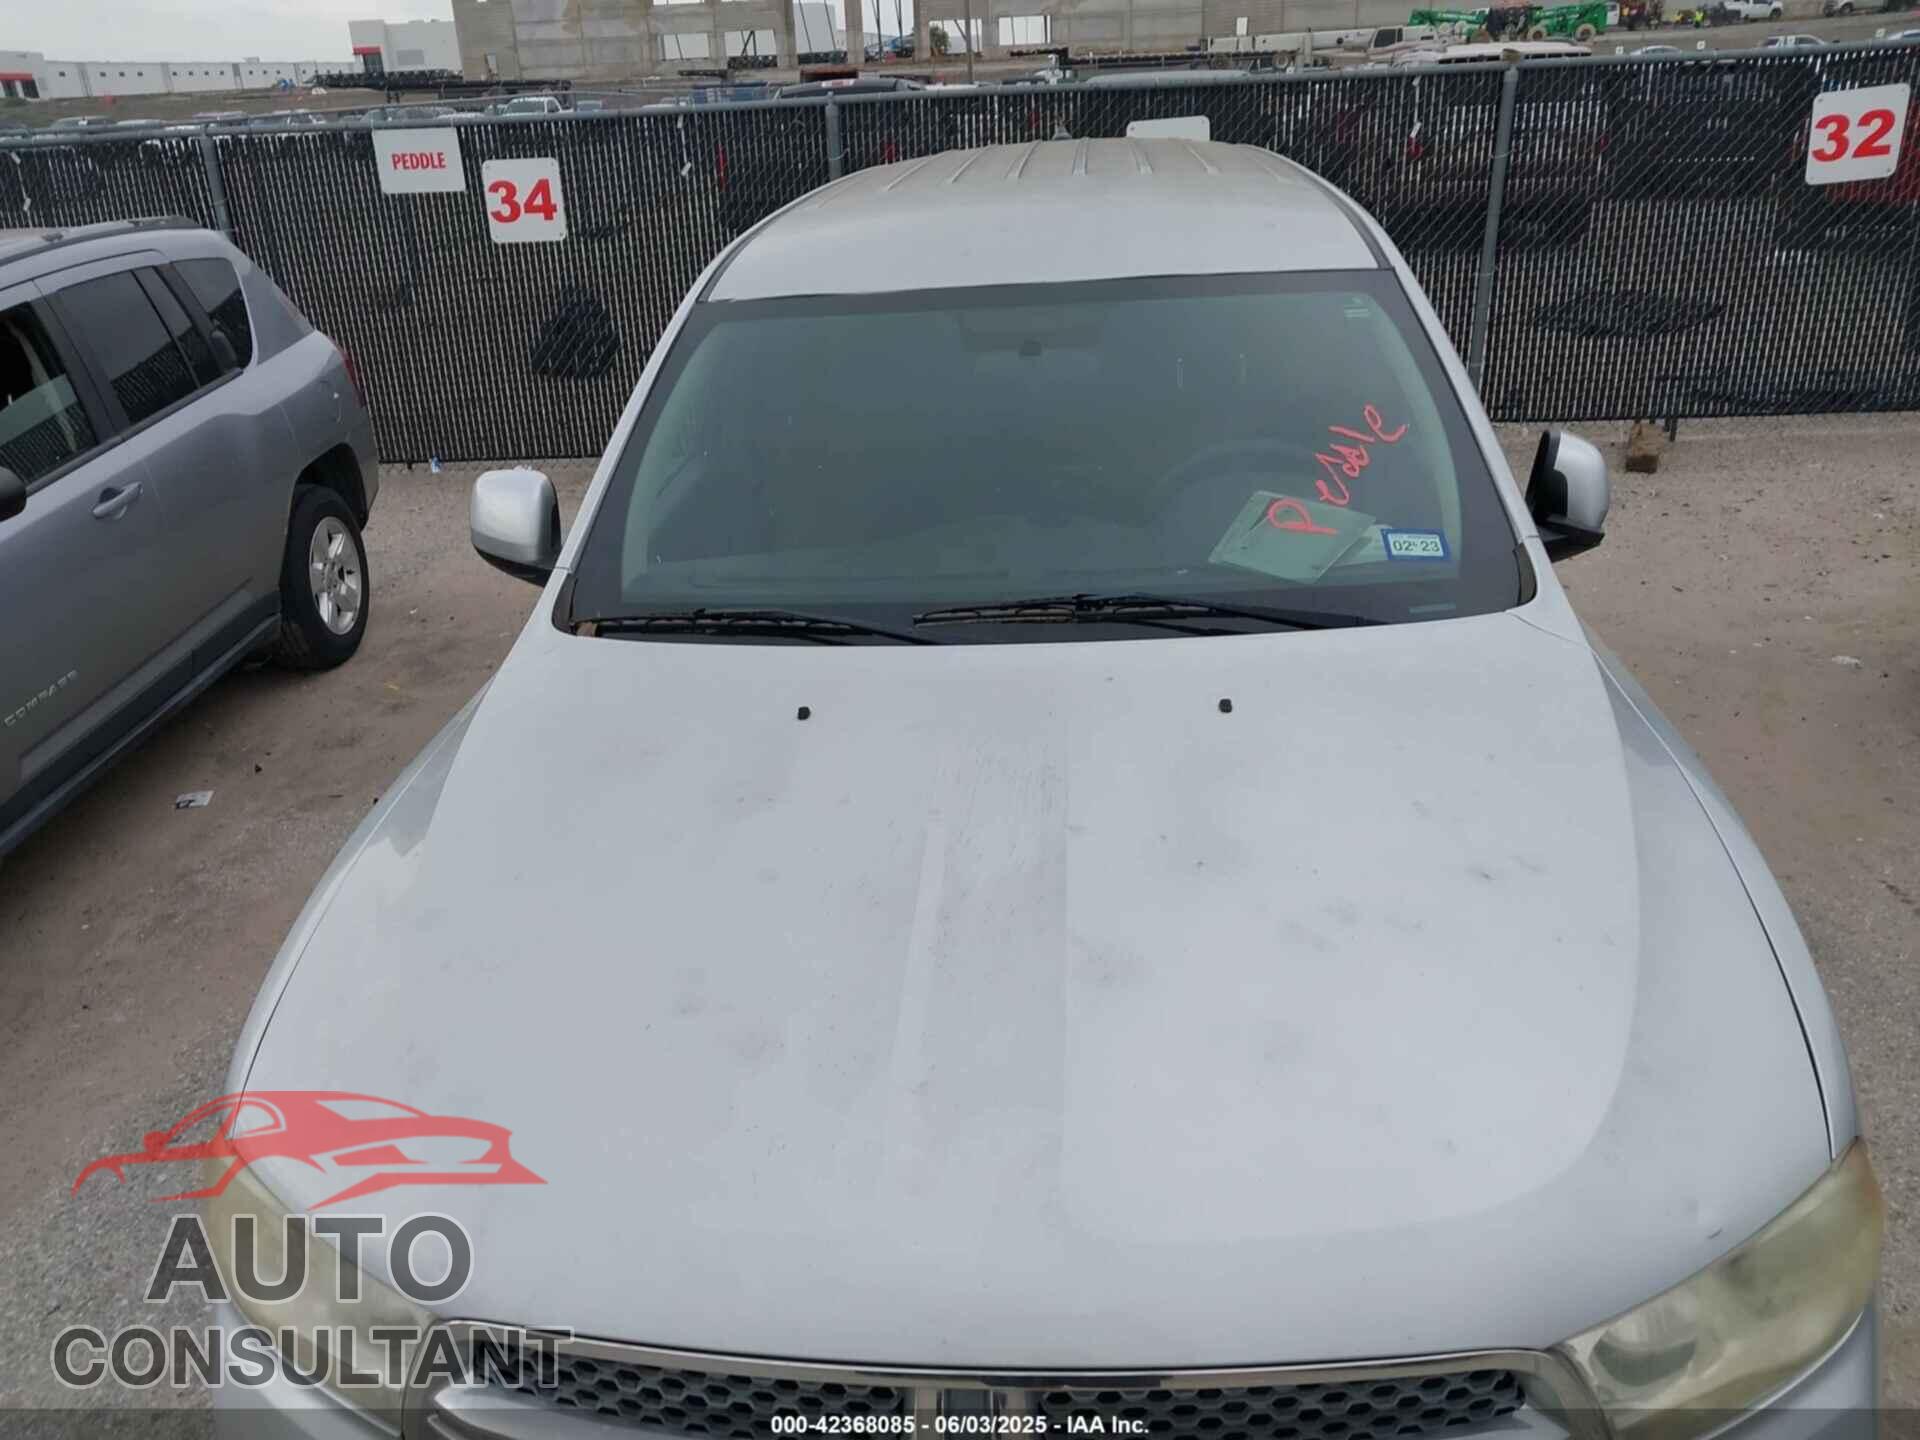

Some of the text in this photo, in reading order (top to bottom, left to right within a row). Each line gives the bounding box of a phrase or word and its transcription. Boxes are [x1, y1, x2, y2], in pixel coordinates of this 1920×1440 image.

[1811, 109, 1896, 162] 32
[391, 151, 446, 170] PEDDLE
[488, 178, 557, 222] 34
